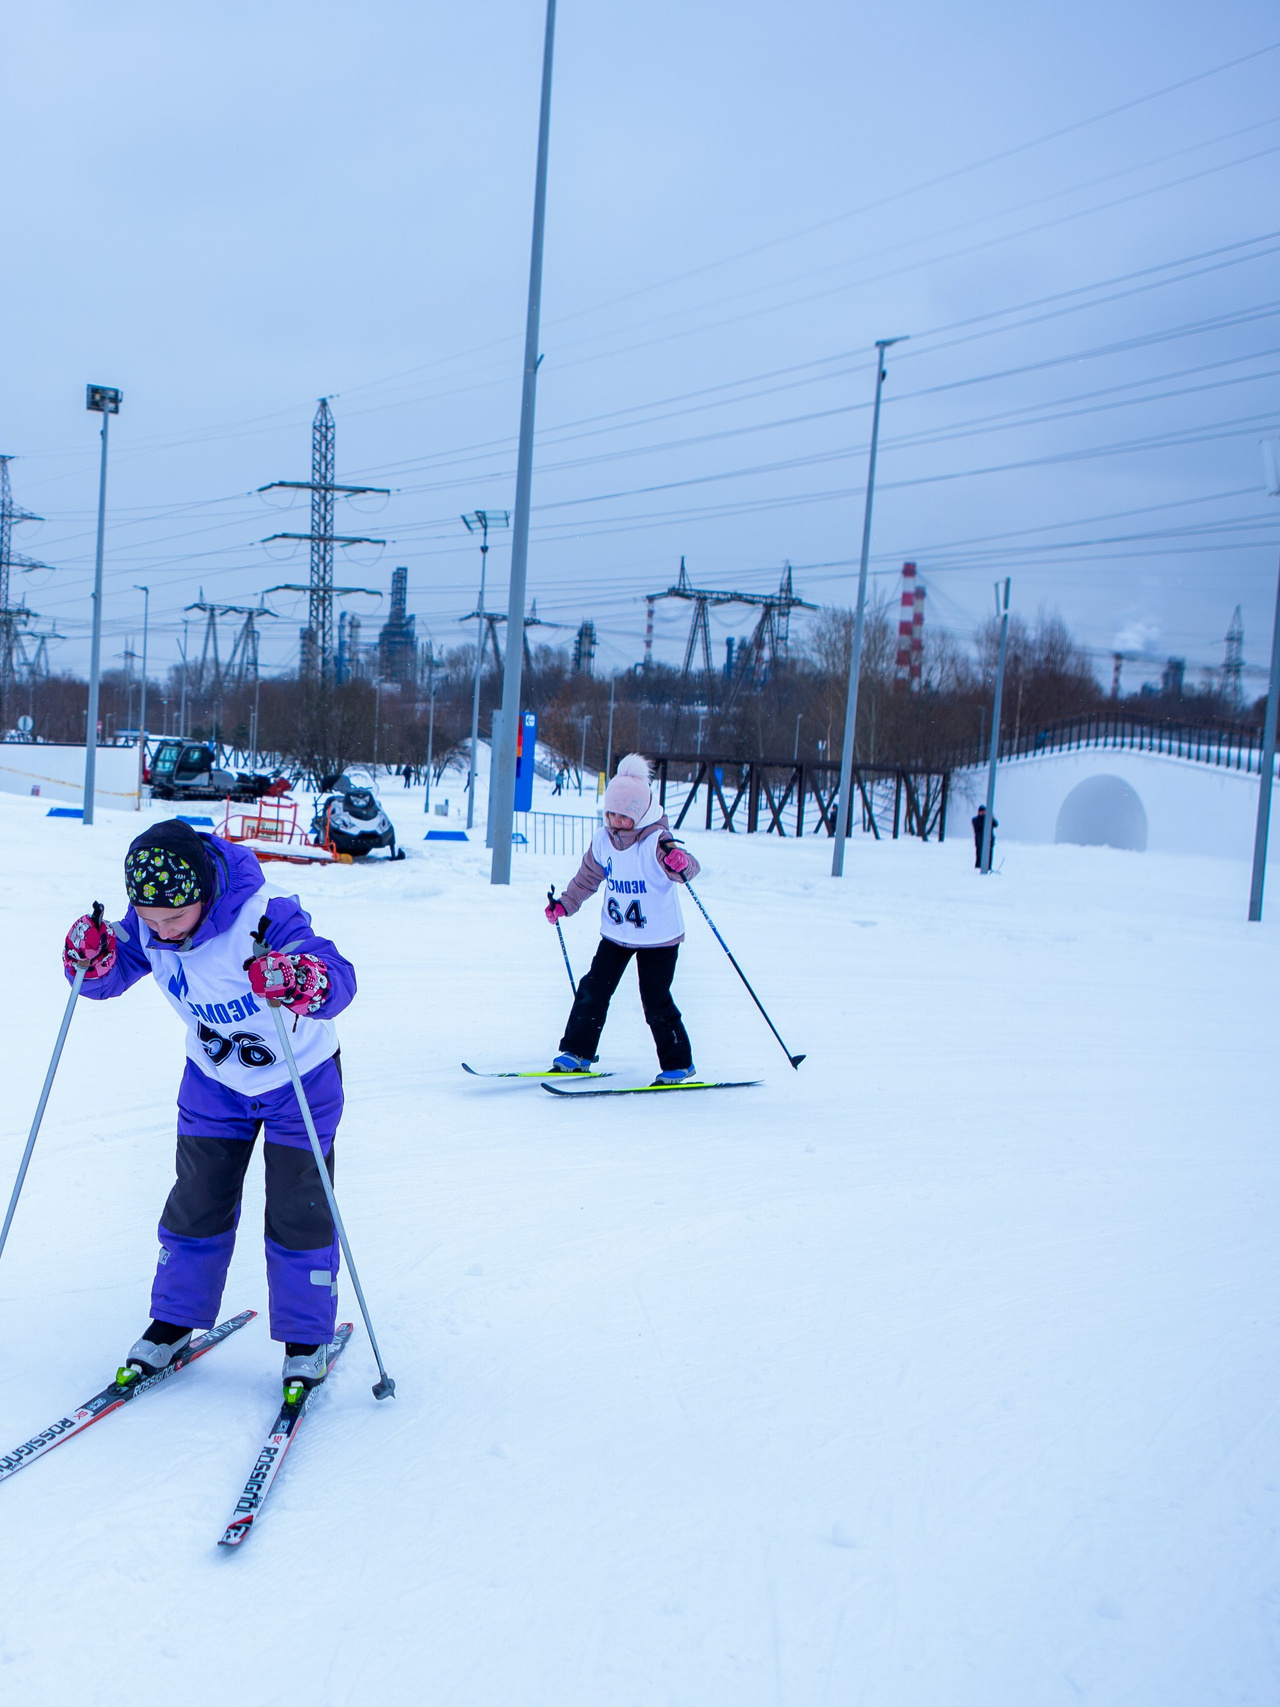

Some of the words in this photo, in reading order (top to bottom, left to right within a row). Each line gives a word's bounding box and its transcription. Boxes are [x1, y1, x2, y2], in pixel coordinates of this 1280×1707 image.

[614, 880, 647, 894] МОЭК
[608, 897, 647, 928] 64
[195, 992, 261, 1024] МОЭК
[197, 1020, 276, 1069] 56
[233, 1446, 279, 1515] ROSSIGNOL
